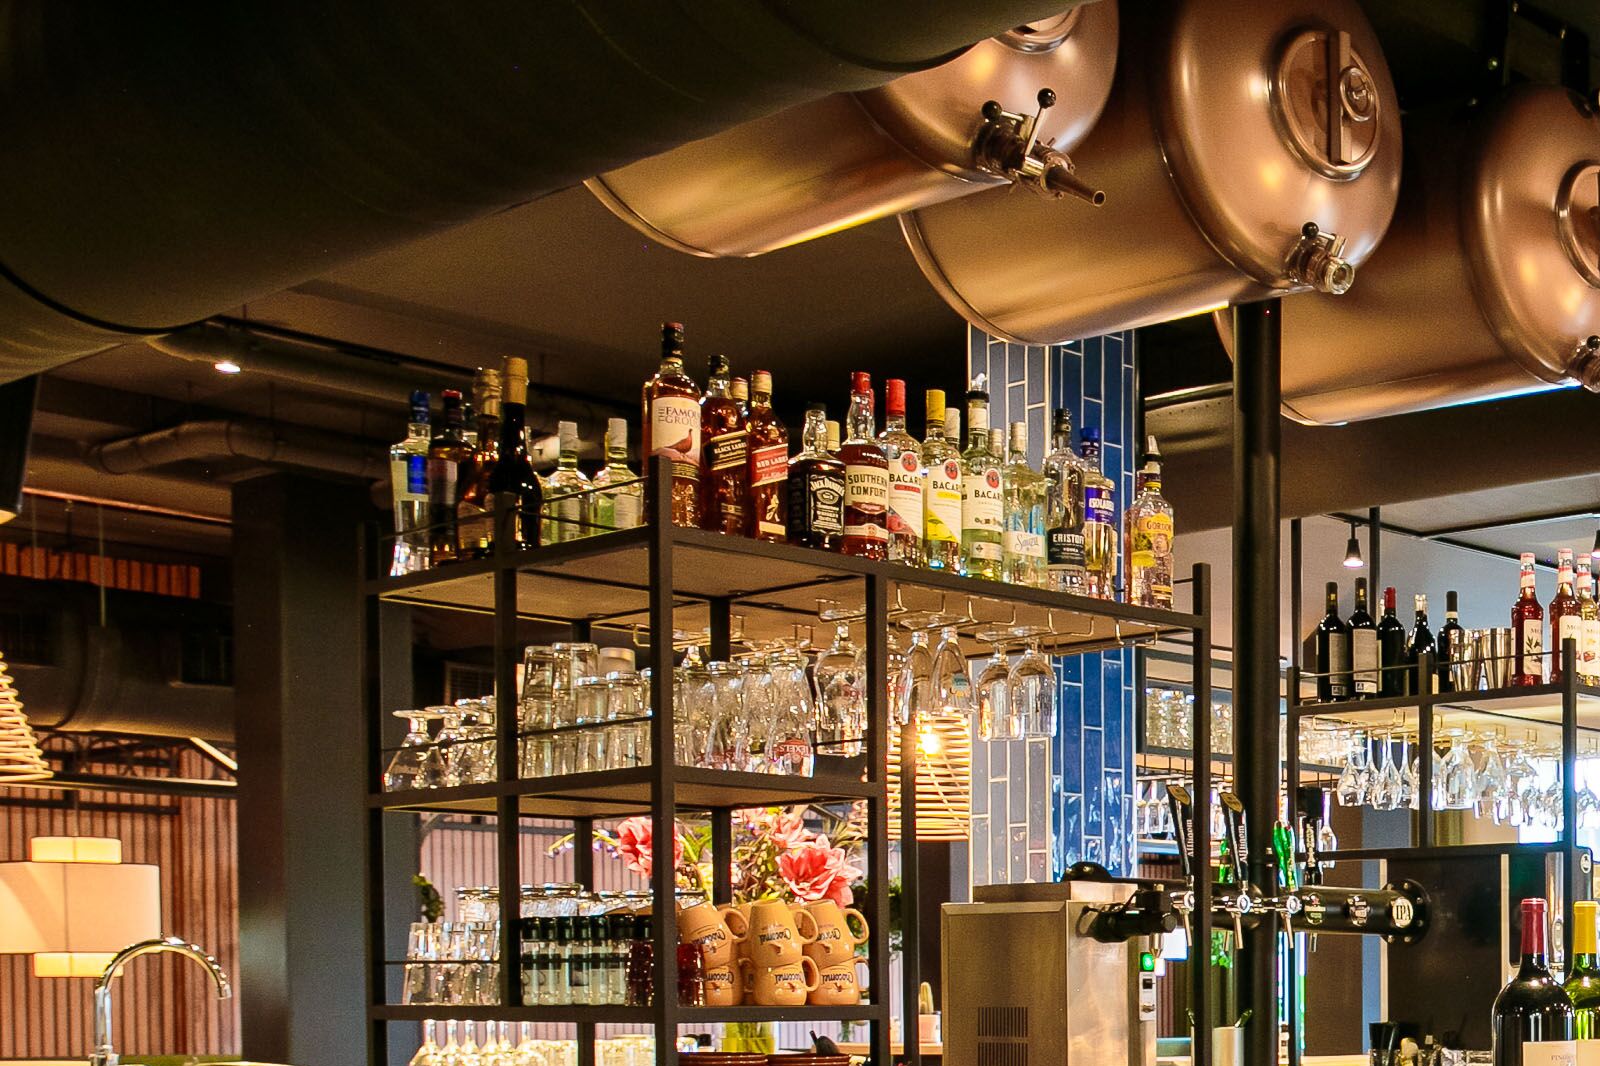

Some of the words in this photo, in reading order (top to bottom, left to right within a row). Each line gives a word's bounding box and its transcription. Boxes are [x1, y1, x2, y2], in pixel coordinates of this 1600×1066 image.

[666, 406, 700, 419] FAMOU
[889, 473, 921, 485] BACAR
[851, 485, 886, 498] COMFORT
[1396, 904, 1411, 920] IPA
